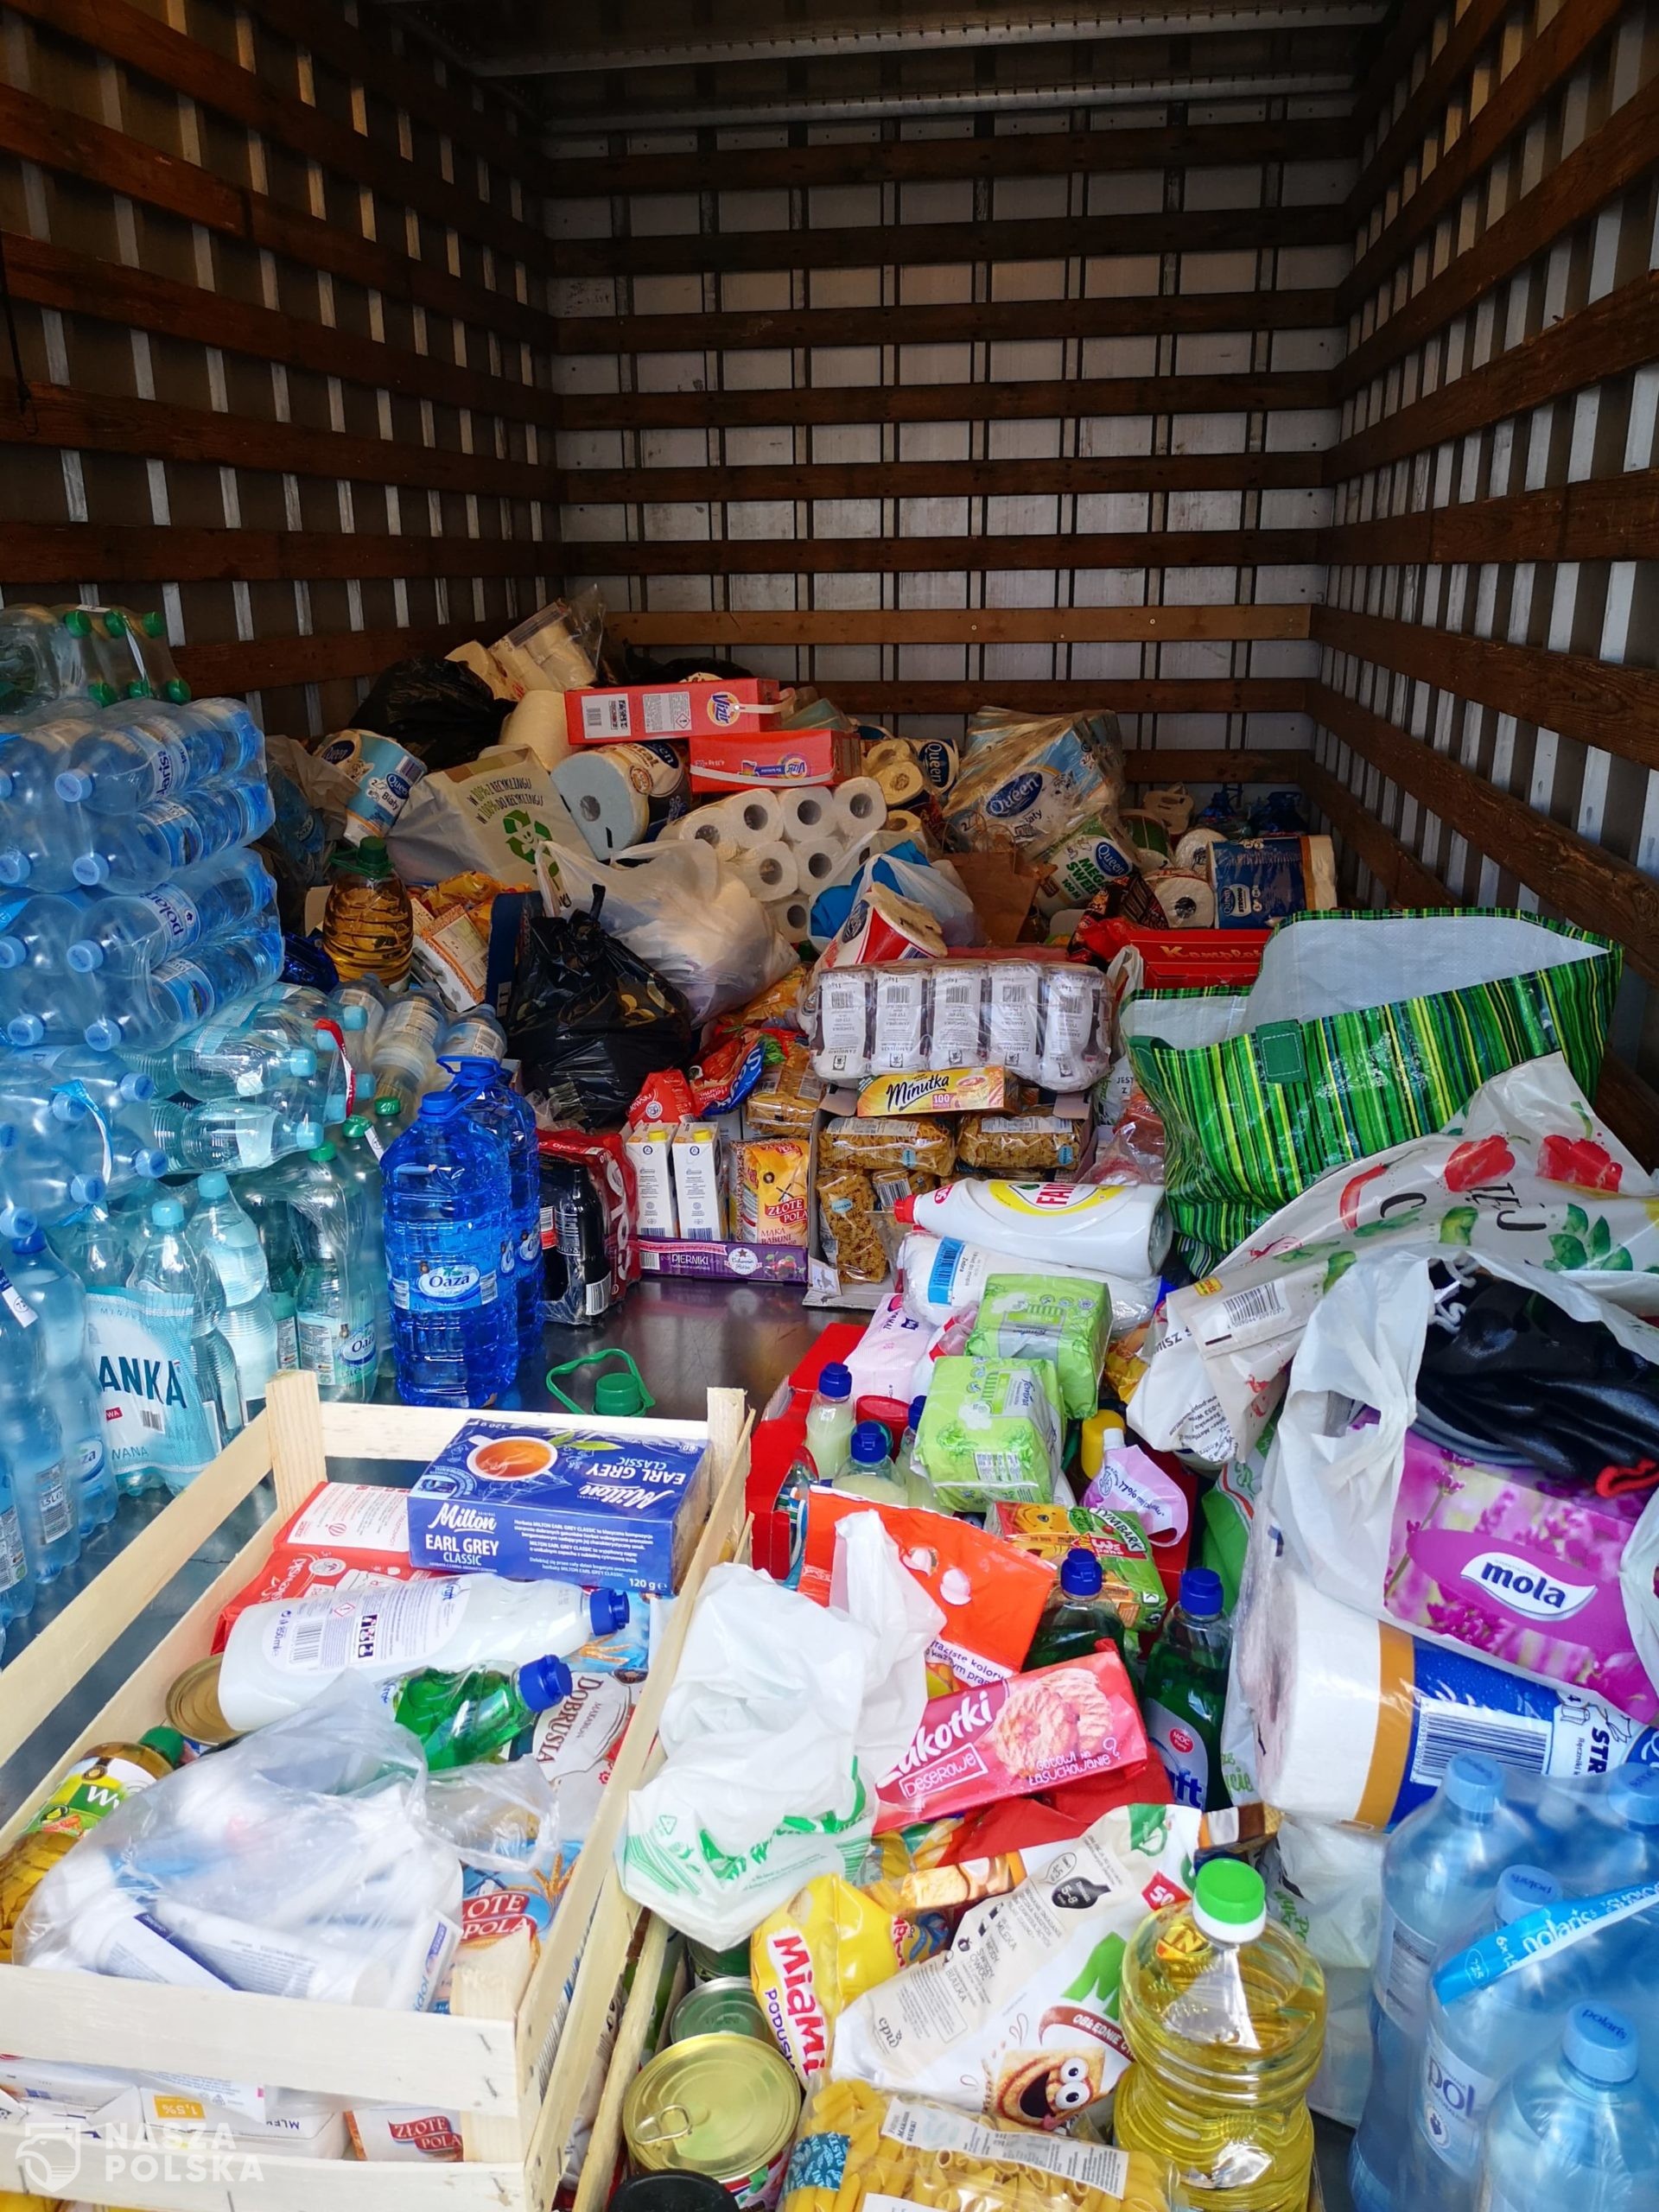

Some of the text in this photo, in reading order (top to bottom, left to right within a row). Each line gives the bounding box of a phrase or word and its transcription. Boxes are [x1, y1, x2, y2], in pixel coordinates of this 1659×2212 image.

[711, 693, 731, 724] Vizir
[927, 742, 942, 783] Queen
[505, 793, 544, 807] RECYKLINGU
[989, 777, 1040, 815] Queen
[1097, 842, 1125, 875] Queen
[886, 1073, 950, 1112] Minutka
[933, 1095, 950, 1104] 100
[766, 1198, 804, 1217] ZŁOTE
[671, 1254, 709, 1266] PIERNIKI
[429, 1274, 471, 1288] Oaza
[586, 1462, 687, 1485] EARL GREY
[615, 1457, 668, 1469] CLASSIC
[577, 1485, 675, 1510] Milton
[428, 1502, 497, 1530] Milton
[1092, 1507, 1144, 1551] TYMBARK
[425, 1534, 499, 1556] EARL GREY
[442, 1552, 482, 1566] CLASSIC
[629, 1578, 646, 1587] 120
[648, 1581, 656, 1592] g
[1479, 1560, 1566, 1609] mola
[970, 1658, 1006, 1681] kolory
[537, 1675, 605, 1764] DOBRUSIA
[1173, 1732, 1191, 1745] MOC
[467, 1894, 525, 1918] OTE
[1581, 2008, 1629, 2040] polaris
[162, 2105, 199, 2116] 1,5%
[394, 2118, 448, 2139] ZŁOTE
[421, 2135, 461, 2150] POLA
